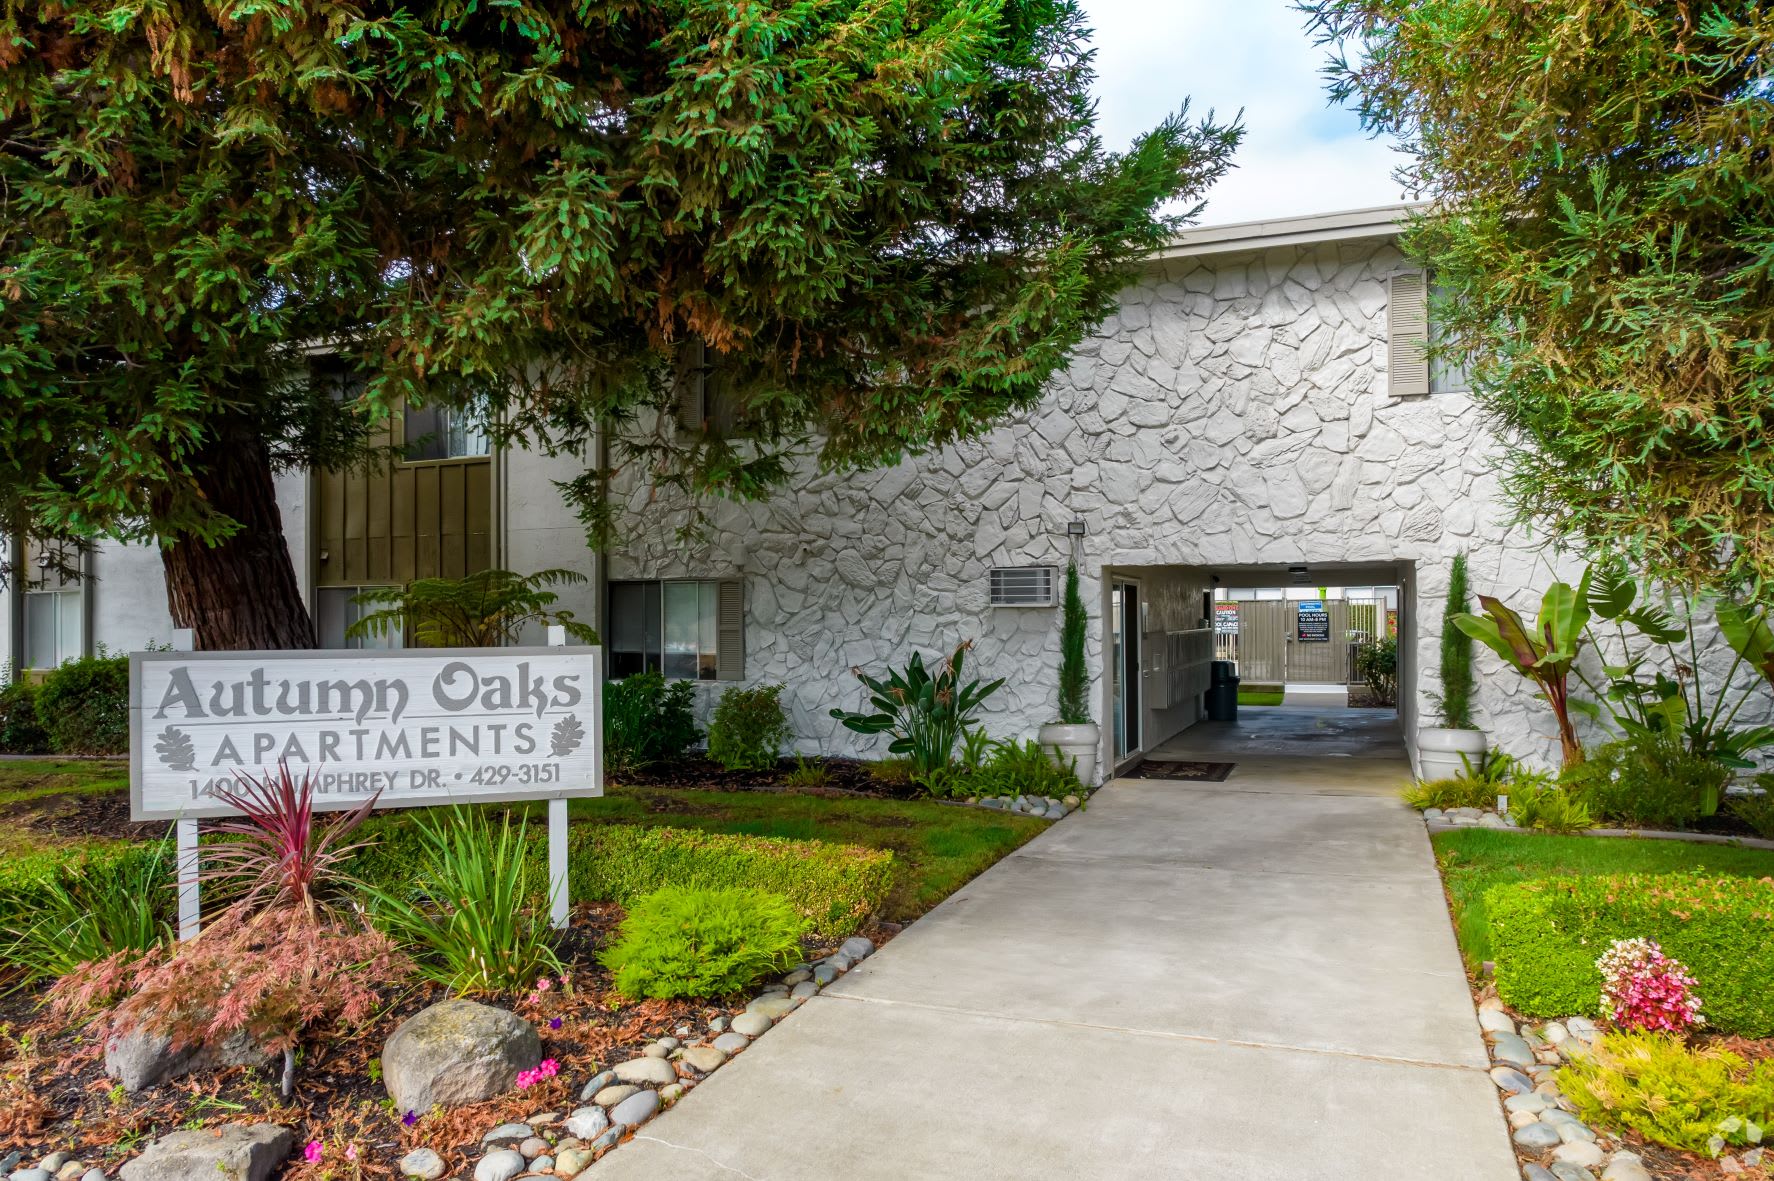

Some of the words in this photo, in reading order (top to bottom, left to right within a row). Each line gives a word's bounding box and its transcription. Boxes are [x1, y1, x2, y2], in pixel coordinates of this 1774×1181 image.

[152, 666, 409, 725] Autumn
[431, 661, 582, 720] Oaks
[210, 722, 537, 767] APARTMENTS
[189, 776, 250, 800] 1400
[409, 768, 447, 790] DR.
[469, 763, 560, 786] 429-3151
